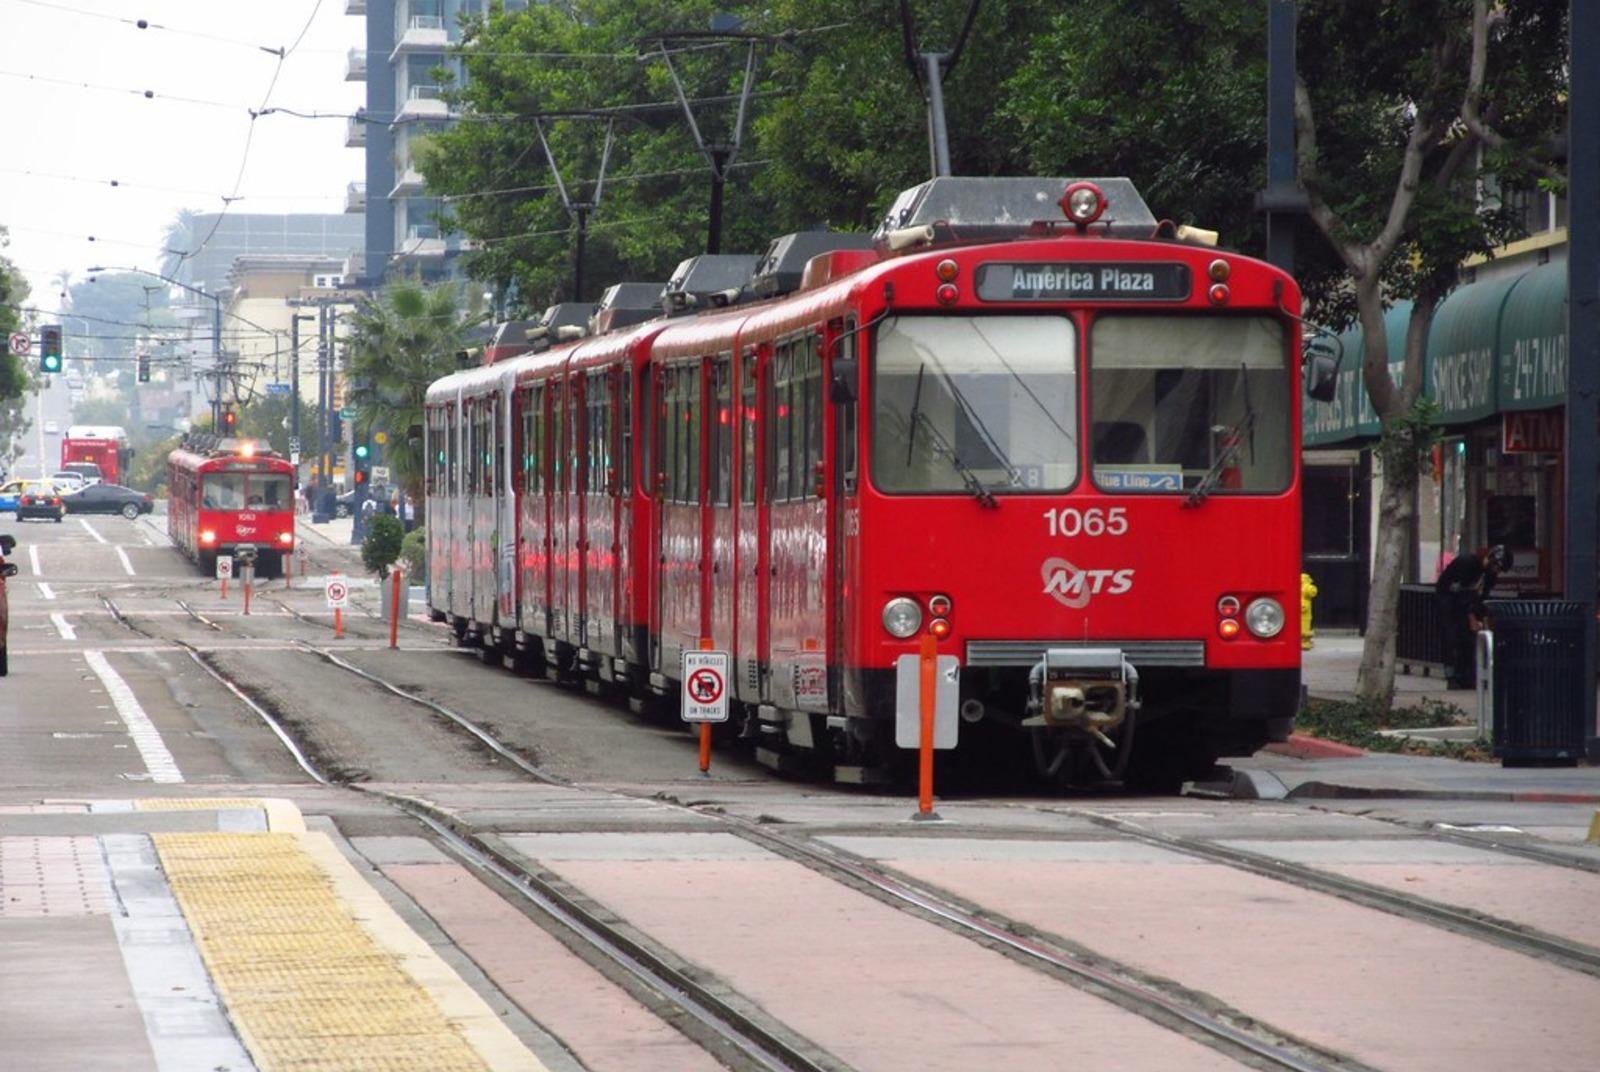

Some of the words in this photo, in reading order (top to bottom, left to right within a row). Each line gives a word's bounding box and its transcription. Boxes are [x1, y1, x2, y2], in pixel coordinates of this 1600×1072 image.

[1101, 267, 1154, 291] Plaza
[1432, 352, 1467, 411] SMOKE
[1468, 348, 1492, 407] SHOP
[1508, 413, 1560, 449] ATM
[1123, 474, 1150, 487] Line
[1043, 507, 1128, 537] 1065
[1042, 568, 1135, 595] MTS
